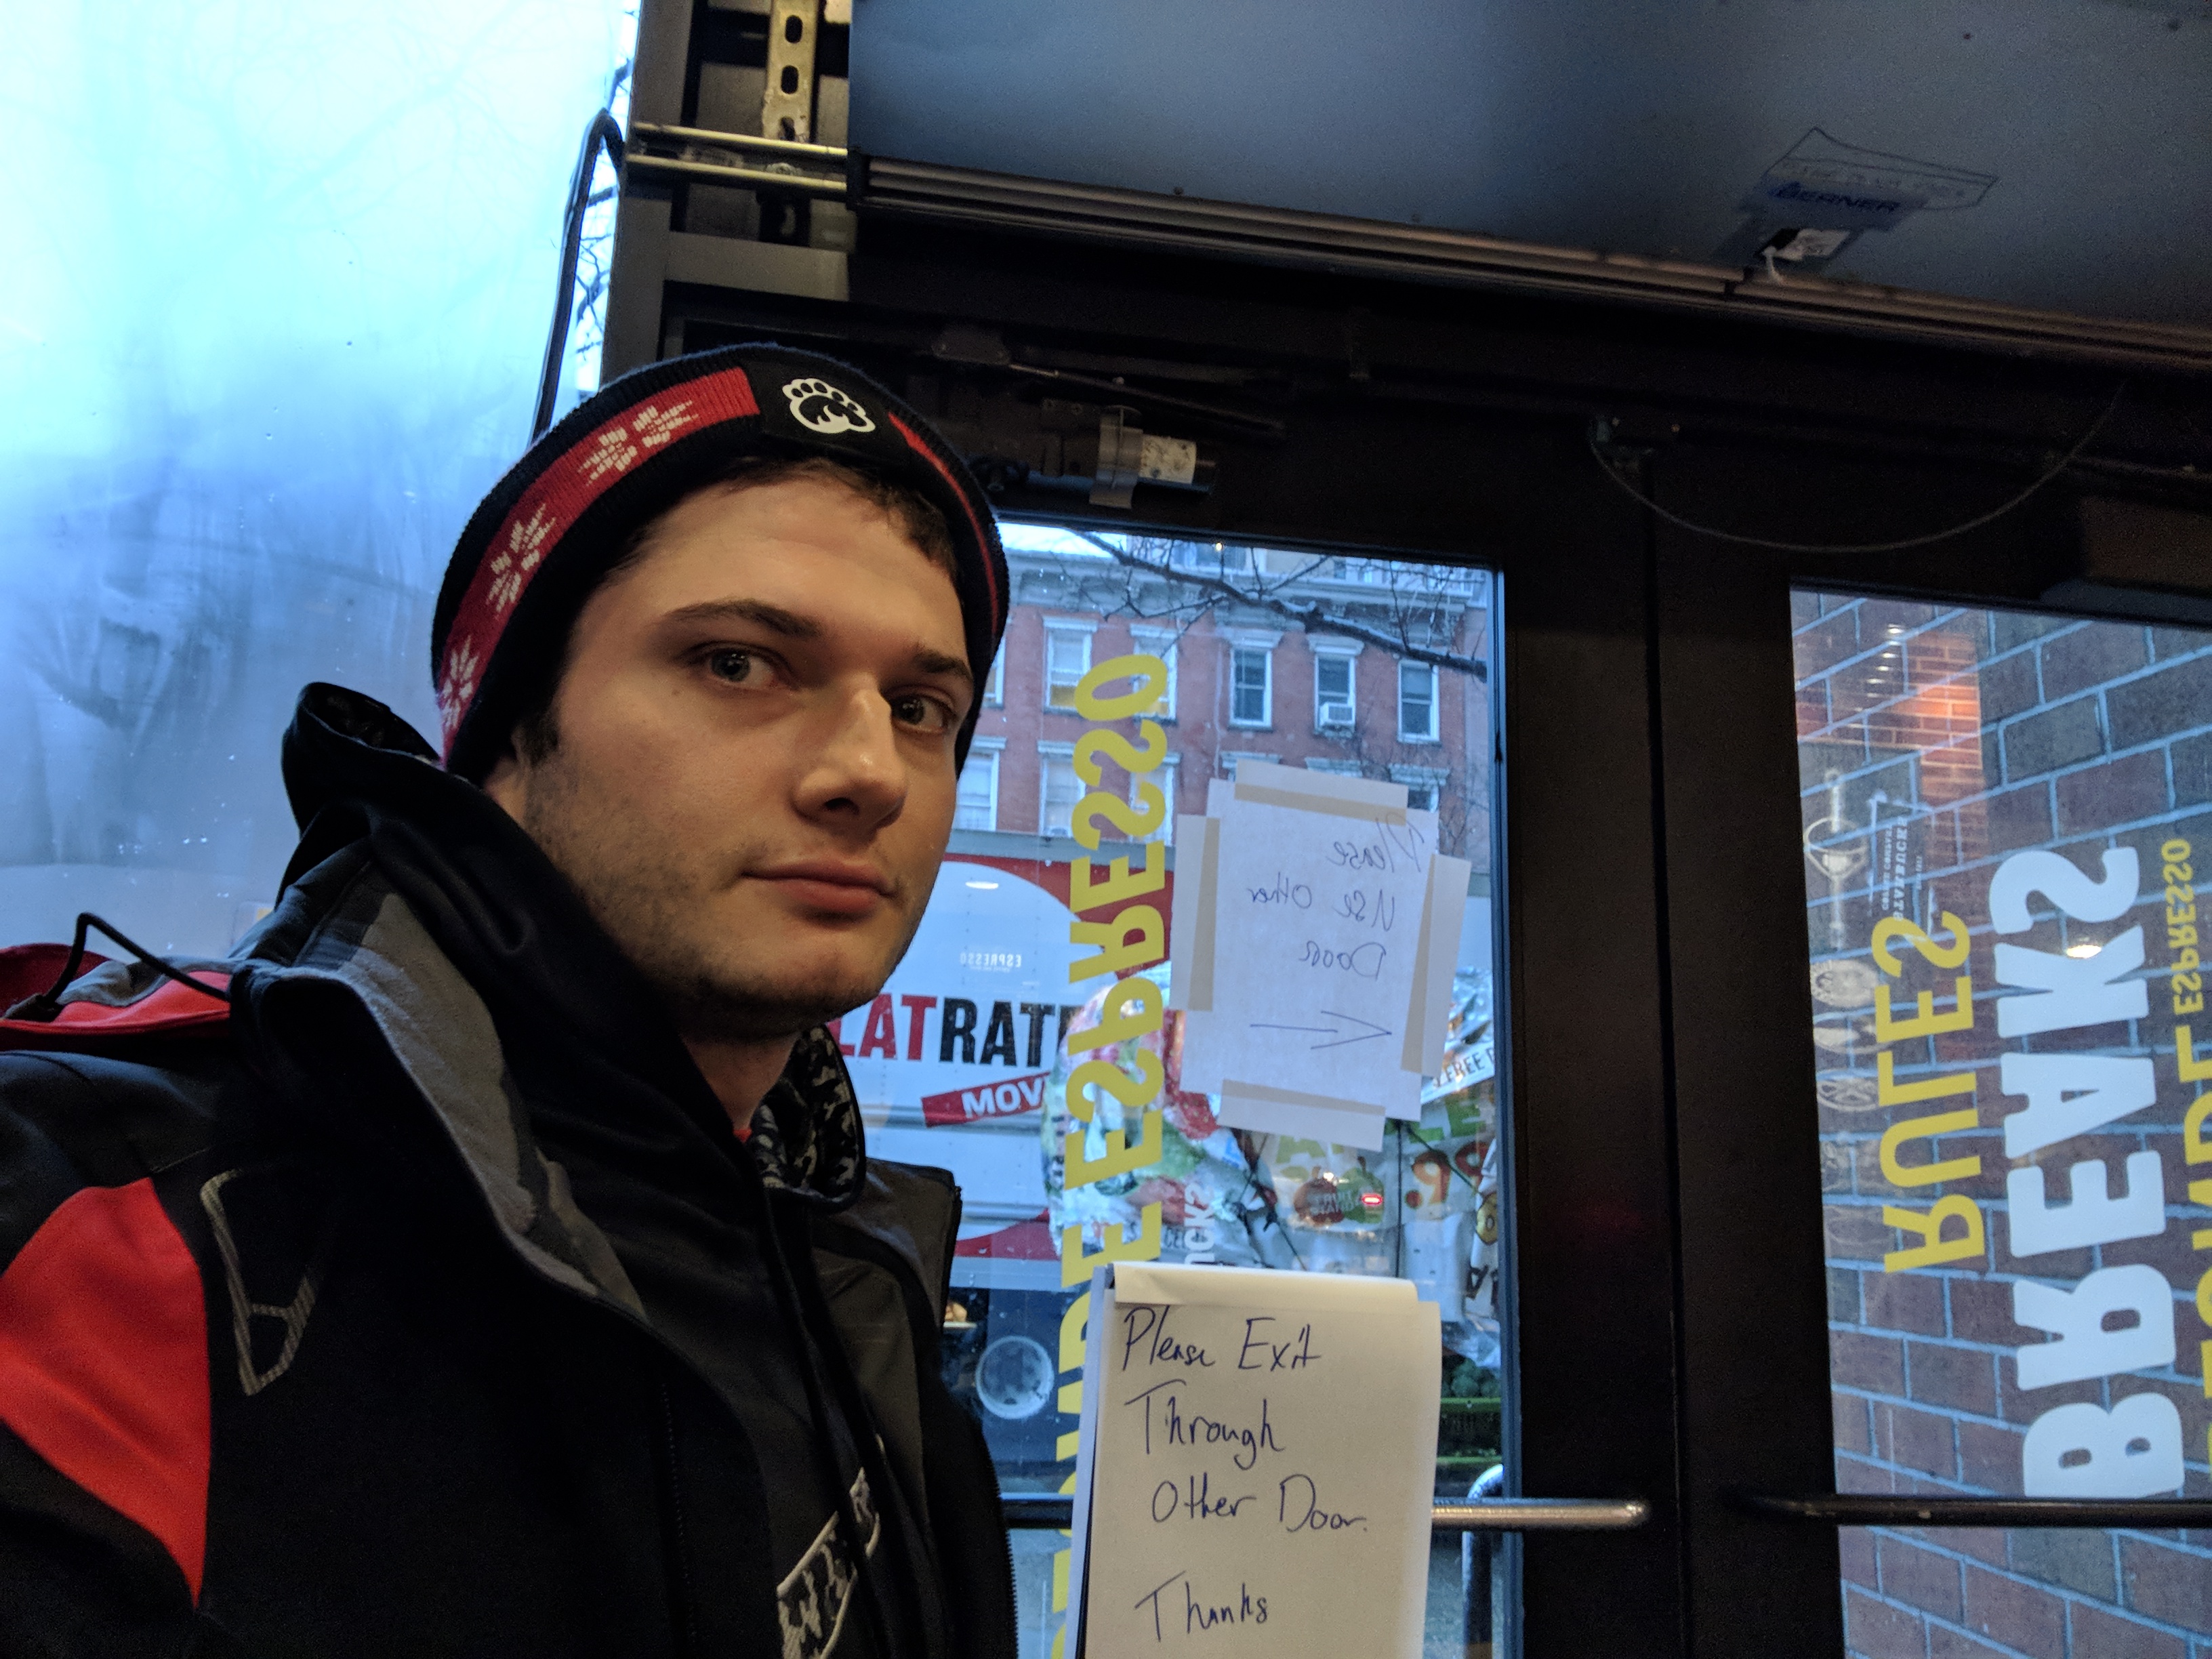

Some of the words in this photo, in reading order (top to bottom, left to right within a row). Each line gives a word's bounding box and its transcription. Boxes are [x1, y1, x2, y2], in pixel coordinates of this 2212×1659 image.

[827, 993, 1081, 1068] LATRAT
[960, 1076, 1046, 1119] MOV
[1237, 1317, 1322, 1372] Exit
[1124, 1379, 1286, 1471] Through
[1152, 1472, 1257, 1523] Other
[1134, 1571, 1269, 1642] Thanks
